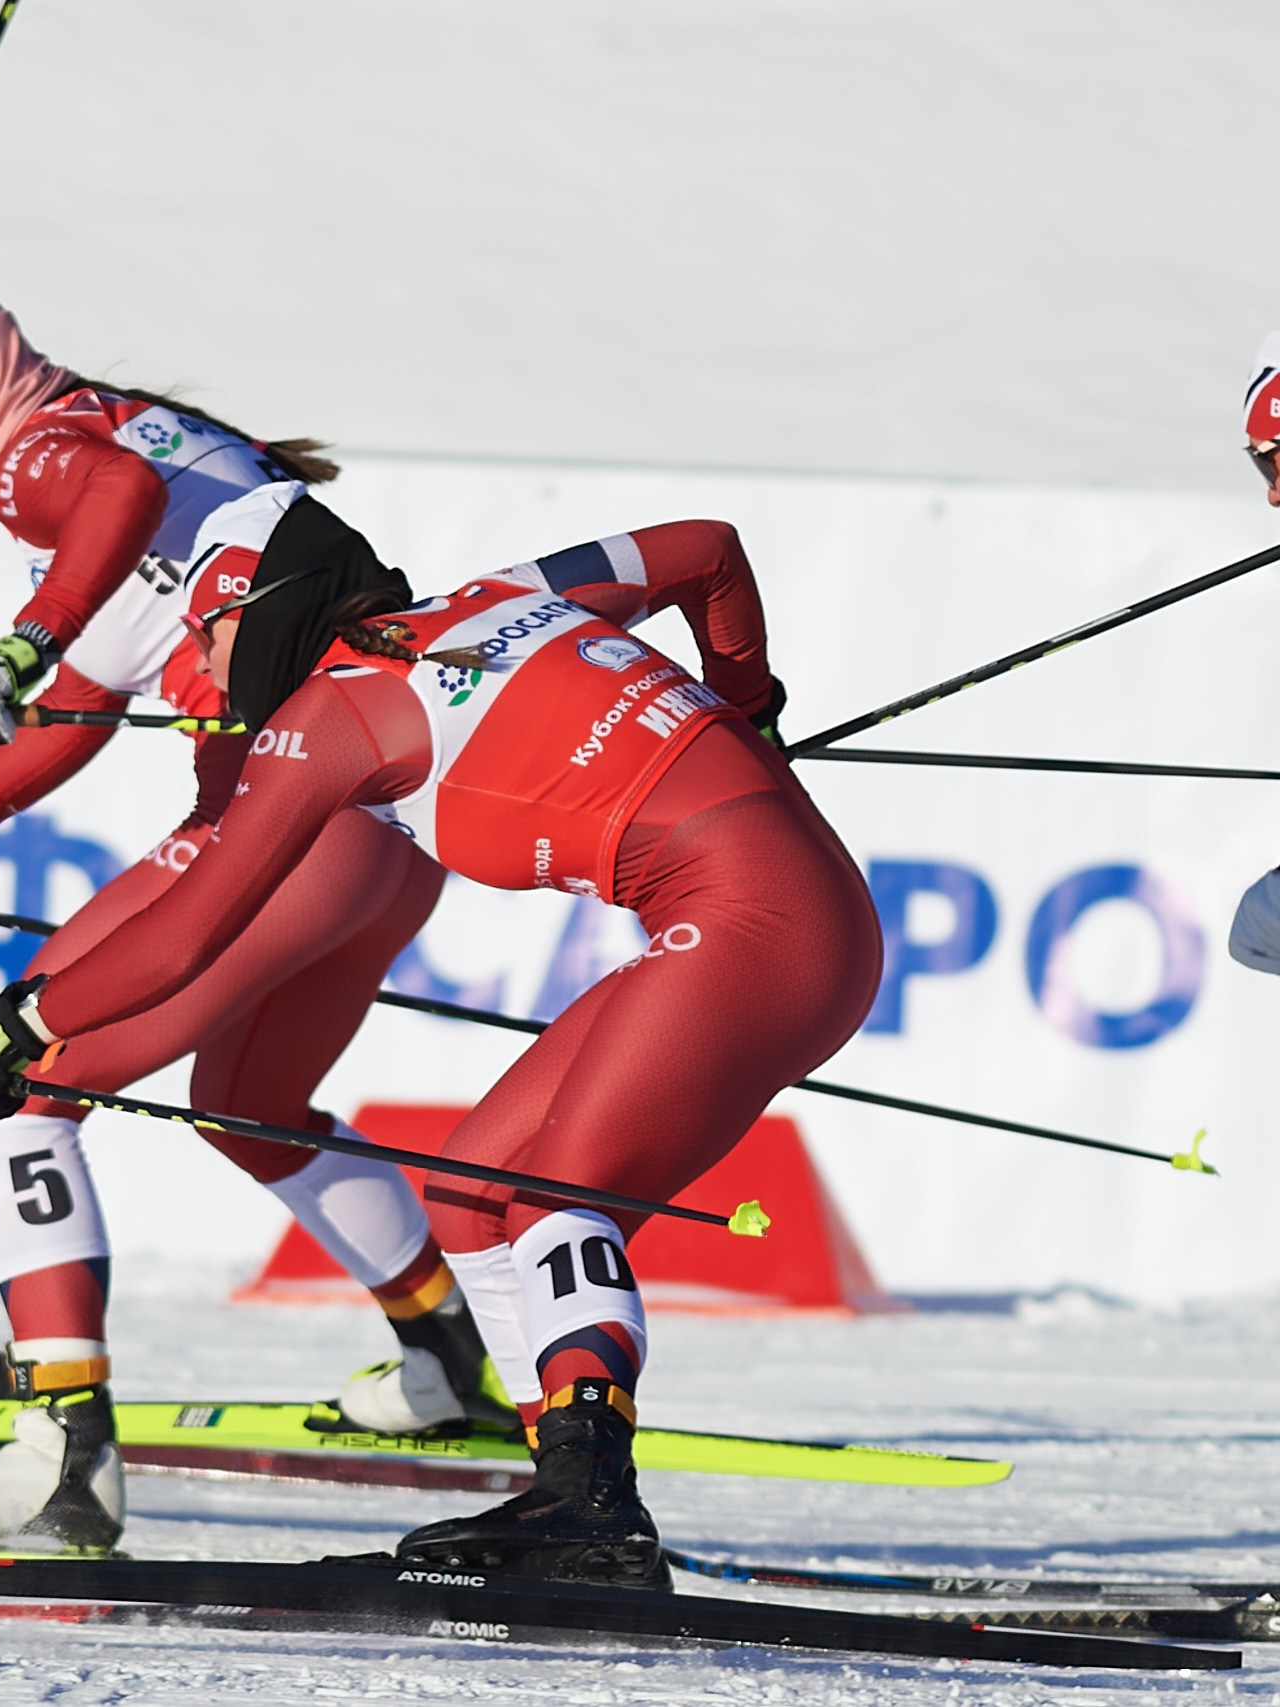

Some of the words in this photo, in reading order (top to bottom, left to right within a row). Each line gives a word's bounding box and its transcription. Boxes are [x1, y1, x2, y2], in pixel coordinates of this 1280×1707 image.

[249, 728, 309, 760] OIL
[570, 696, 634, 768] Кубок
[144, 836, 200, 873] CO
[534, 837, 553, 877] года
[8, 1147, 74, 1226] 5
[536, 1235, 637, 1300] 10
[397, 1570, 487, 1588] ATOMIC
[428, 1620, 510, 1640] ATOMIC
